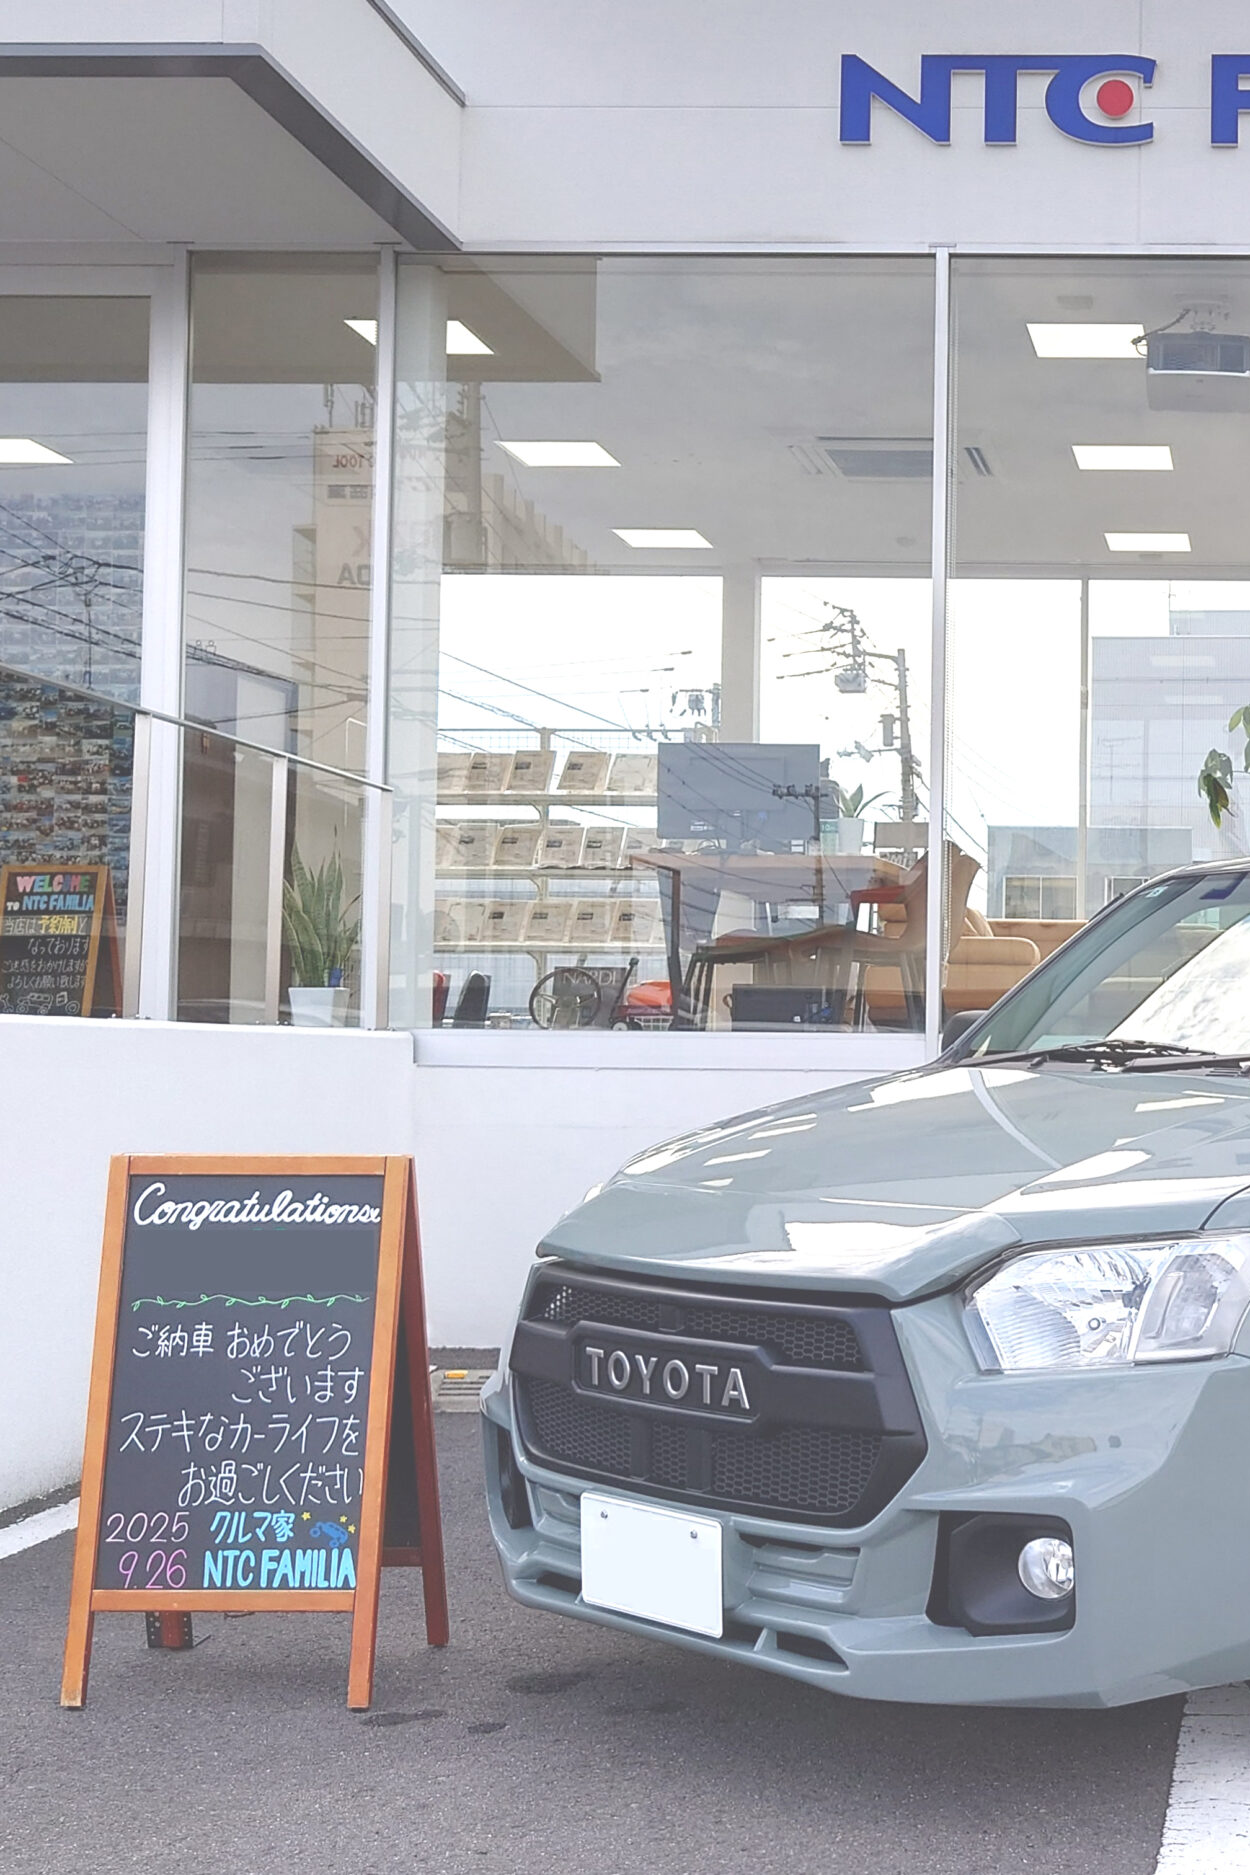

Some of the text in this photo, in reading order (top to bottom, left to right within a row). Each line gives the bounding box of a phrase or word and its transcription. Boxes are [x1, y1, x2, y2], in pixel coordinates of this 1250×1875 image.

[839, 54, 1157, 147] NTC
[6, 894, 94, 912] TO NTC FAMILIA
[16, 874, 90, 893] WELCOME
[133, 1182, 381, 1230] Congratulations
[131, 1320, 352, 1361] ご納車 おめでとう
[231, 1363, 365, 1404] ございます
[584, 1345, 751, 1410] TOYOTA
[119, 1409, 361, 1456] ステキなカーライフを
[177, 1460, 364, 1507] お過ごしください
[105, 1510, 190, 1543] 2025
[209, 1509, 296, 1545] クルマ家
[203, 1548, 357, 1589] NTC FAMILIA
